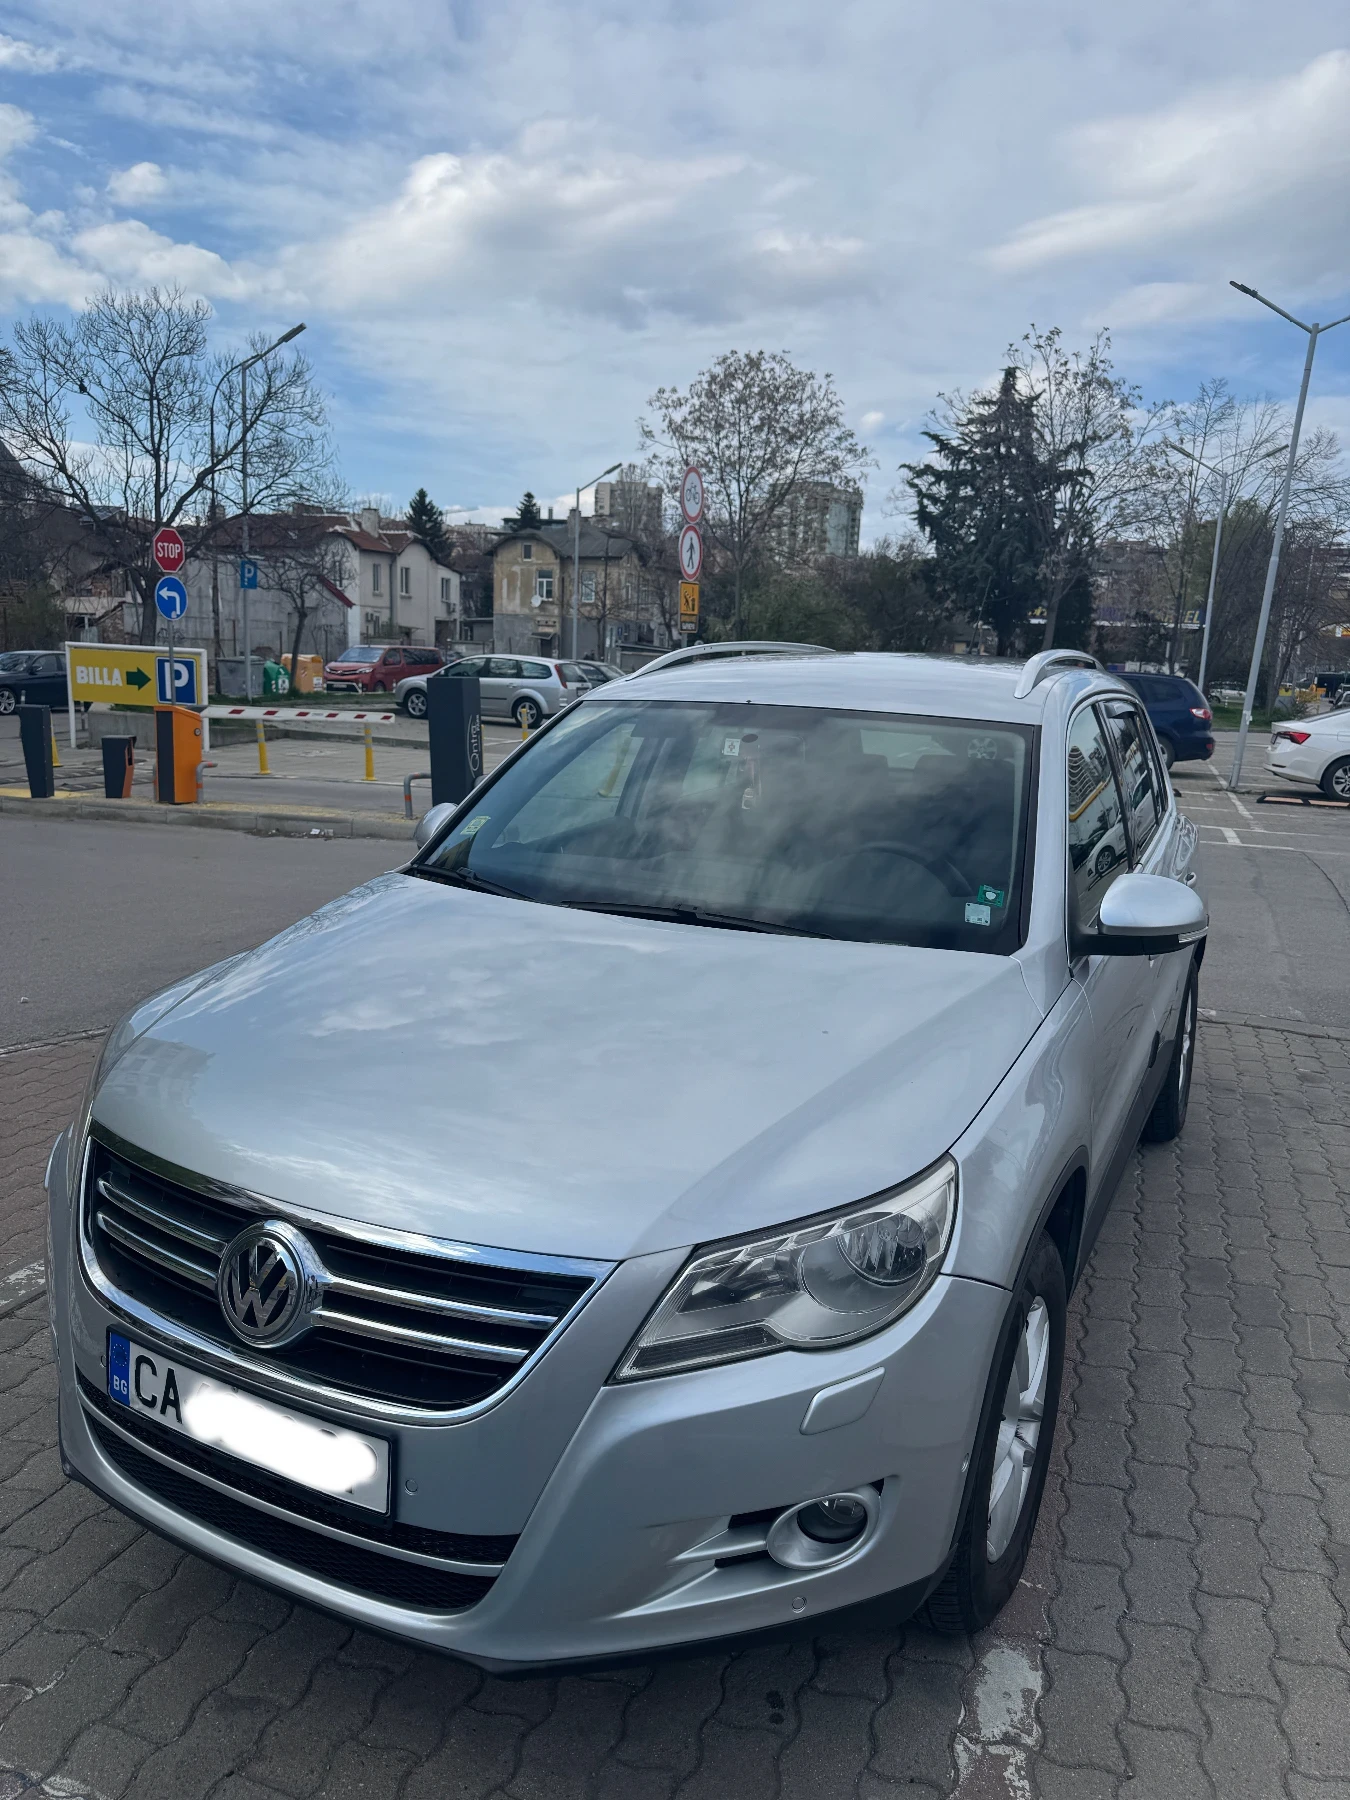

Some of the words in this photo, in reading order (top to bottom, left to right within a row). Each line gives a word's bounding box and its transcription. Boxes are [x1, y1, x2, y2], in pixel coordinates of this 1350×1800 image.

[157, 541, 181, 559] STOP
[244, 564, 254, 585] P
[75, 665, 123, 687] BILLA
[164, 661, 189, 700] P
[113, 1374, 128, 1395] BG
[134, 1354, 183, 1425] CA
